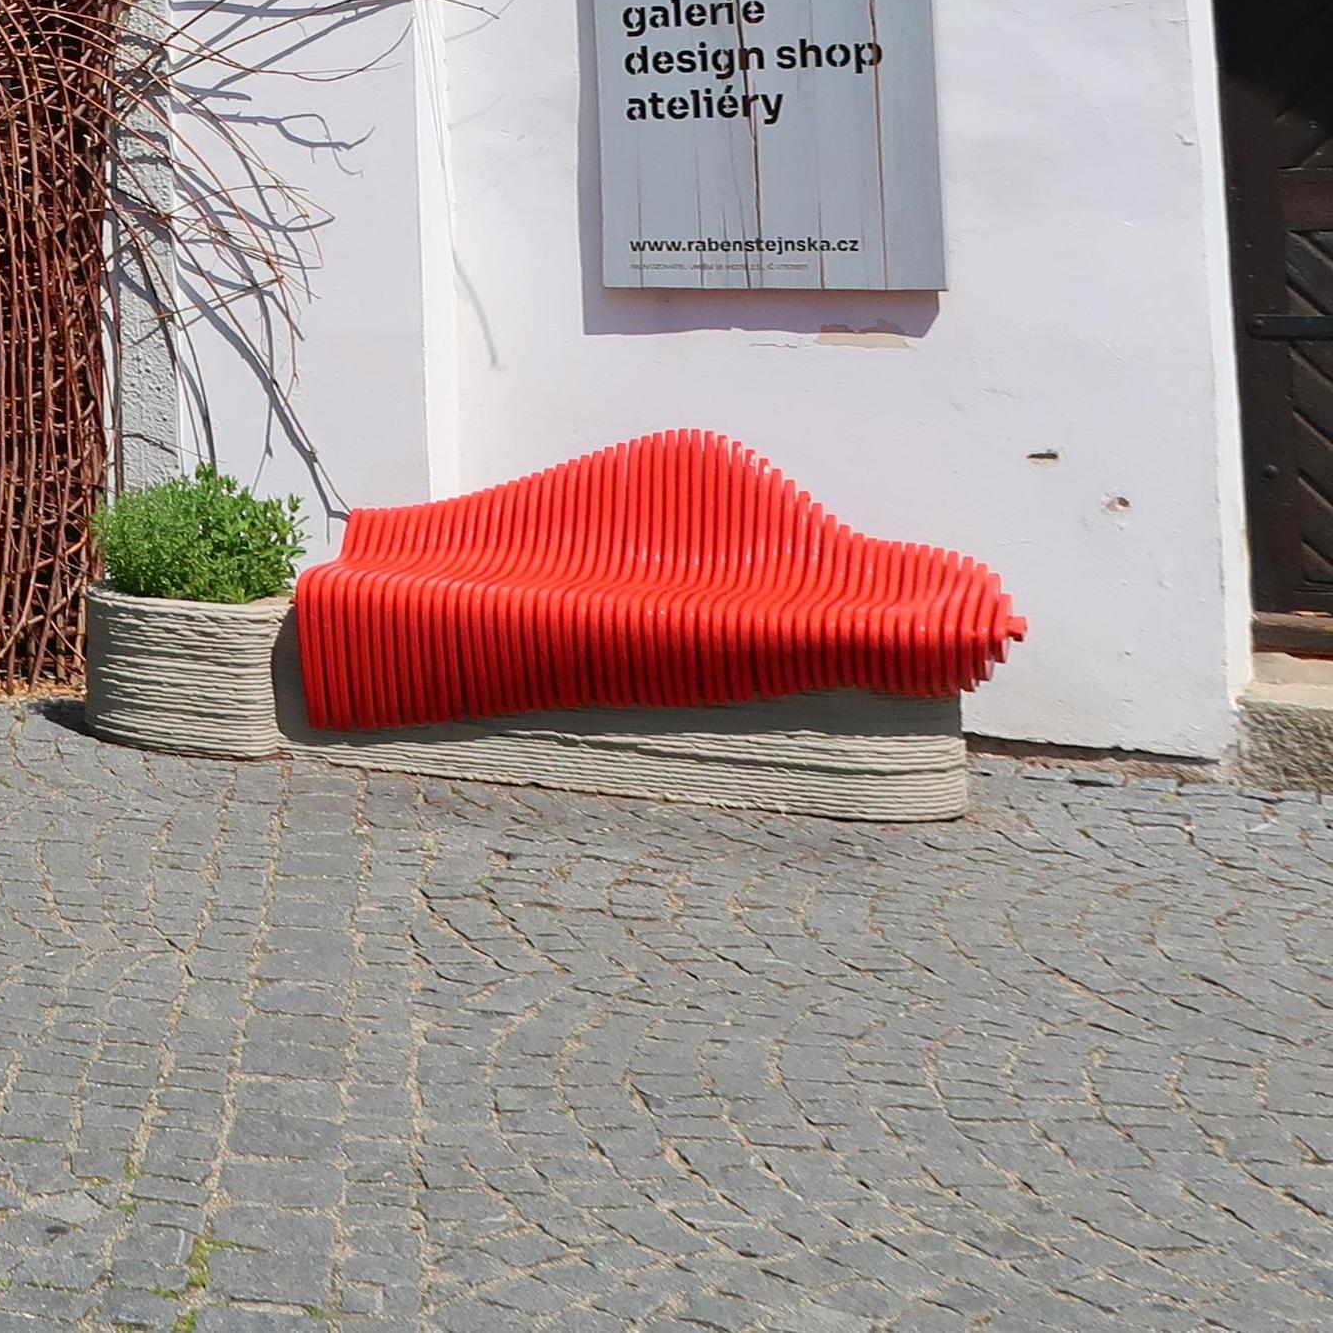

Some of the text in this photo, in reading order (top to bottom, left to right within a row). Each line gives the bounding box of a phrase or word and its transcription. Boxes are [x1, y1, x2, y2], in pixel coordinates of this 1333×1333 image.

[624, 38, 883, 80] design shop
[625, 84, 784, 125] ateliéry
[629, 236, 860, 255] www.rabenstejnska.cz
